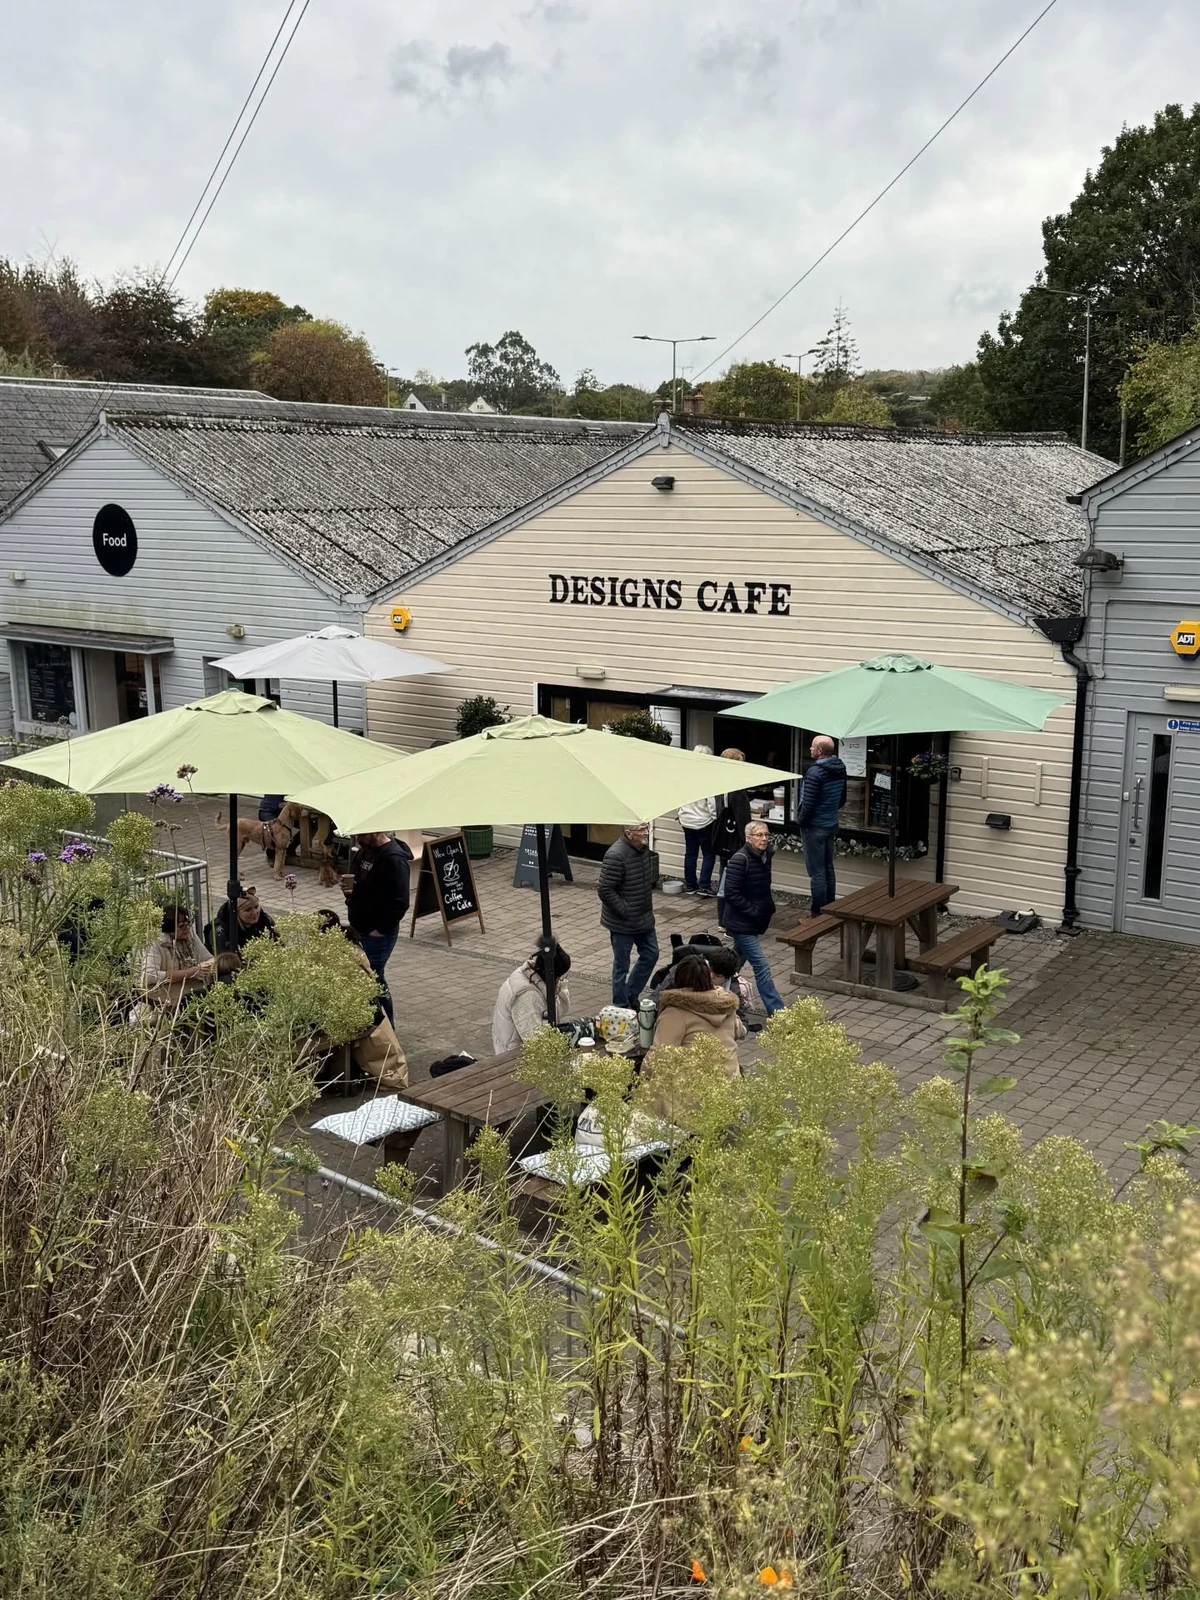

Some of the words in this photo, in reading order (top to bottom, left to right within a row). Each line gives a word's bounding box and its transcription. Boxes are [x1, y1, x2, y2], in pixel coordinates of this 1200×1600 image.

[102, 532, 127, 547] Food
[548, 574, 682, 609] DESIGNS
[697, 580, 792, 616] CAFE
[1177, 634, 1196, 645] ADT
[444, 893, 463, 904] Coffee
[456, 899, 473, 911] Cake
